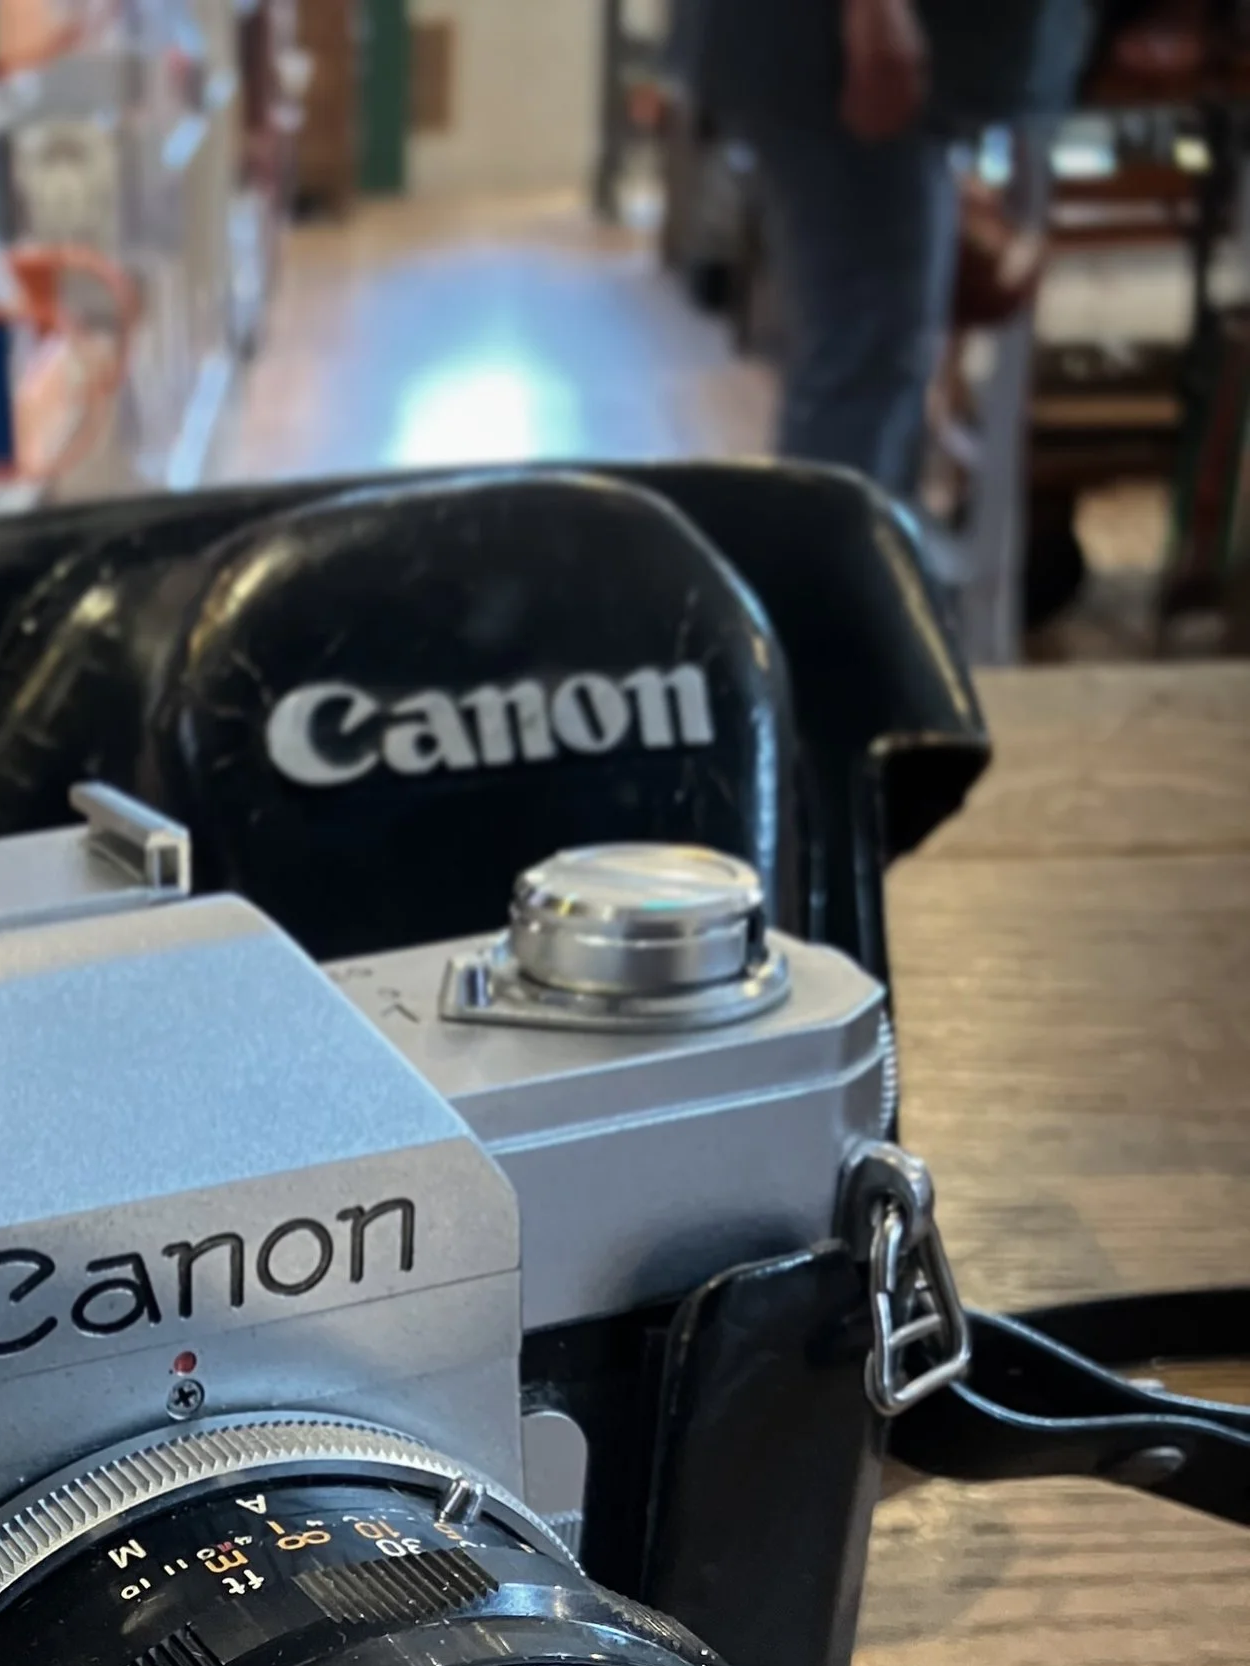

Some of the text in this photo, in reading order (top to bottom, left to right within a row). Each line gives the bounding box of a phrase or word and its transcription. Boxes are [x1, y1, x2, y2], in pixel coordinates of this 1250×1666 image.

[266, 664, 716, 786] Canon
[235, 1493, 267, 1514] A
[107, 1538, 147, 1569] M
[374, 1537, 423, 1558] 30
[204, 1549, 249, 1574] m
[221, 1568, 265, 1596] ft
